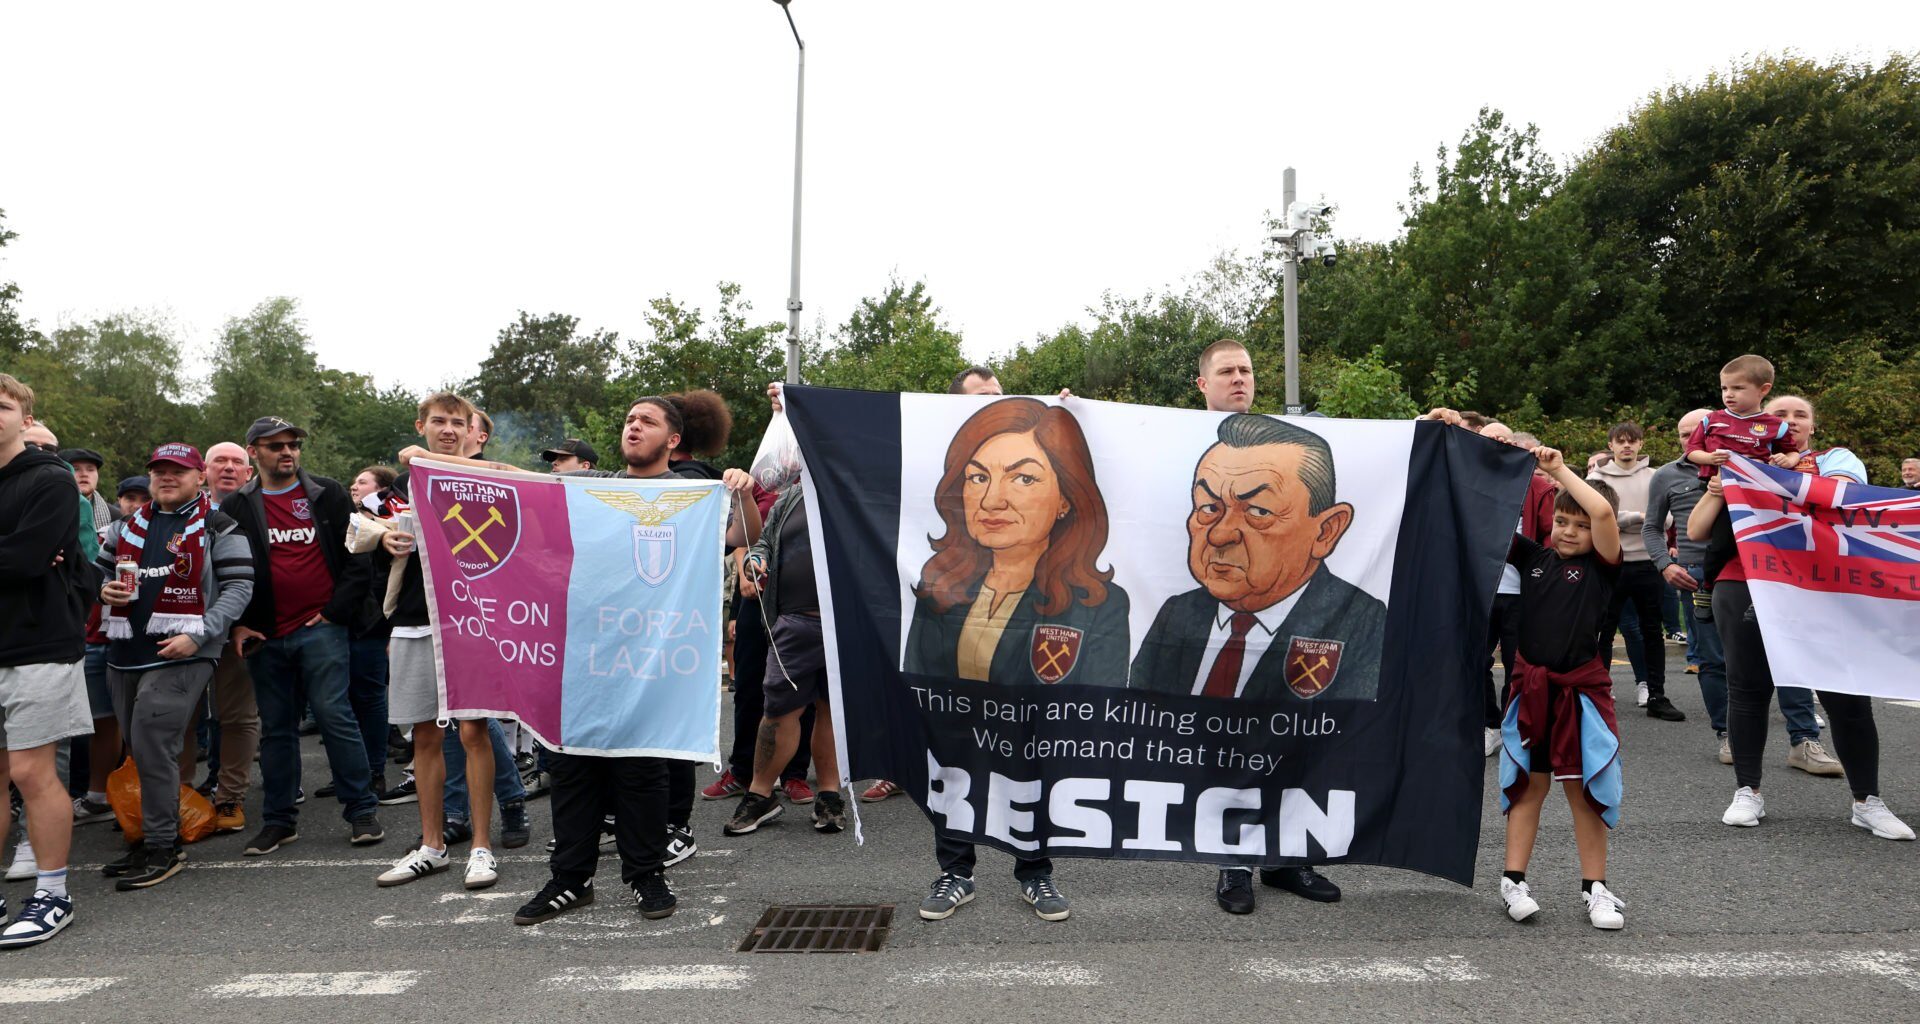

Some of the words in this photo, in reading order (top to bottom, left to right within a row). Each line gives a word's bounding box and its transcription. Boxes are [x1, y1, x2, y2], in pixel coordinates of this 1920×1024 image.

[439, 481, 474, 493] WEST
[477, 484, 508, 500] HAM
[454, 492, 495, 503] UNITED
[268, 527, 316, 544] tway
[1752, 554, 1803, 582] IES,
[1812, 564, 1899, 593] LIES,
[163, 586, 197, 595] BOYLE
[507, 600, 549, 627] ON
[598, 606, 709, 639] FORZA
[1040, 627, 1059, 635] WEST
[1060, 629, 1078, 639] HAM
[1045, 634, 1069, 642] UNITED
[1296, 640, 1320, 649] WEST
[1320, 642, 1338, 652] HAM
[497, 639, 556, 667] ONS
[588, 643, 700, 680] LAZIO
[910, 686, 971, 714] This
[983, 697, 1038, 723] pair
[1046, 702, 1094, 721] are
[1104, 698, 1197, 736] killing
[1206, 715, 1260, 735] our
[1270, 712, 1342, 737] Club.
[972, 727, 1014, 758] We
[1024, 735, 1134, 760] demand
[1146, 739, 1207, 766] that
[1217, 747, 1284, 776] they
[926, 748, 1356, 859] RESIGN
